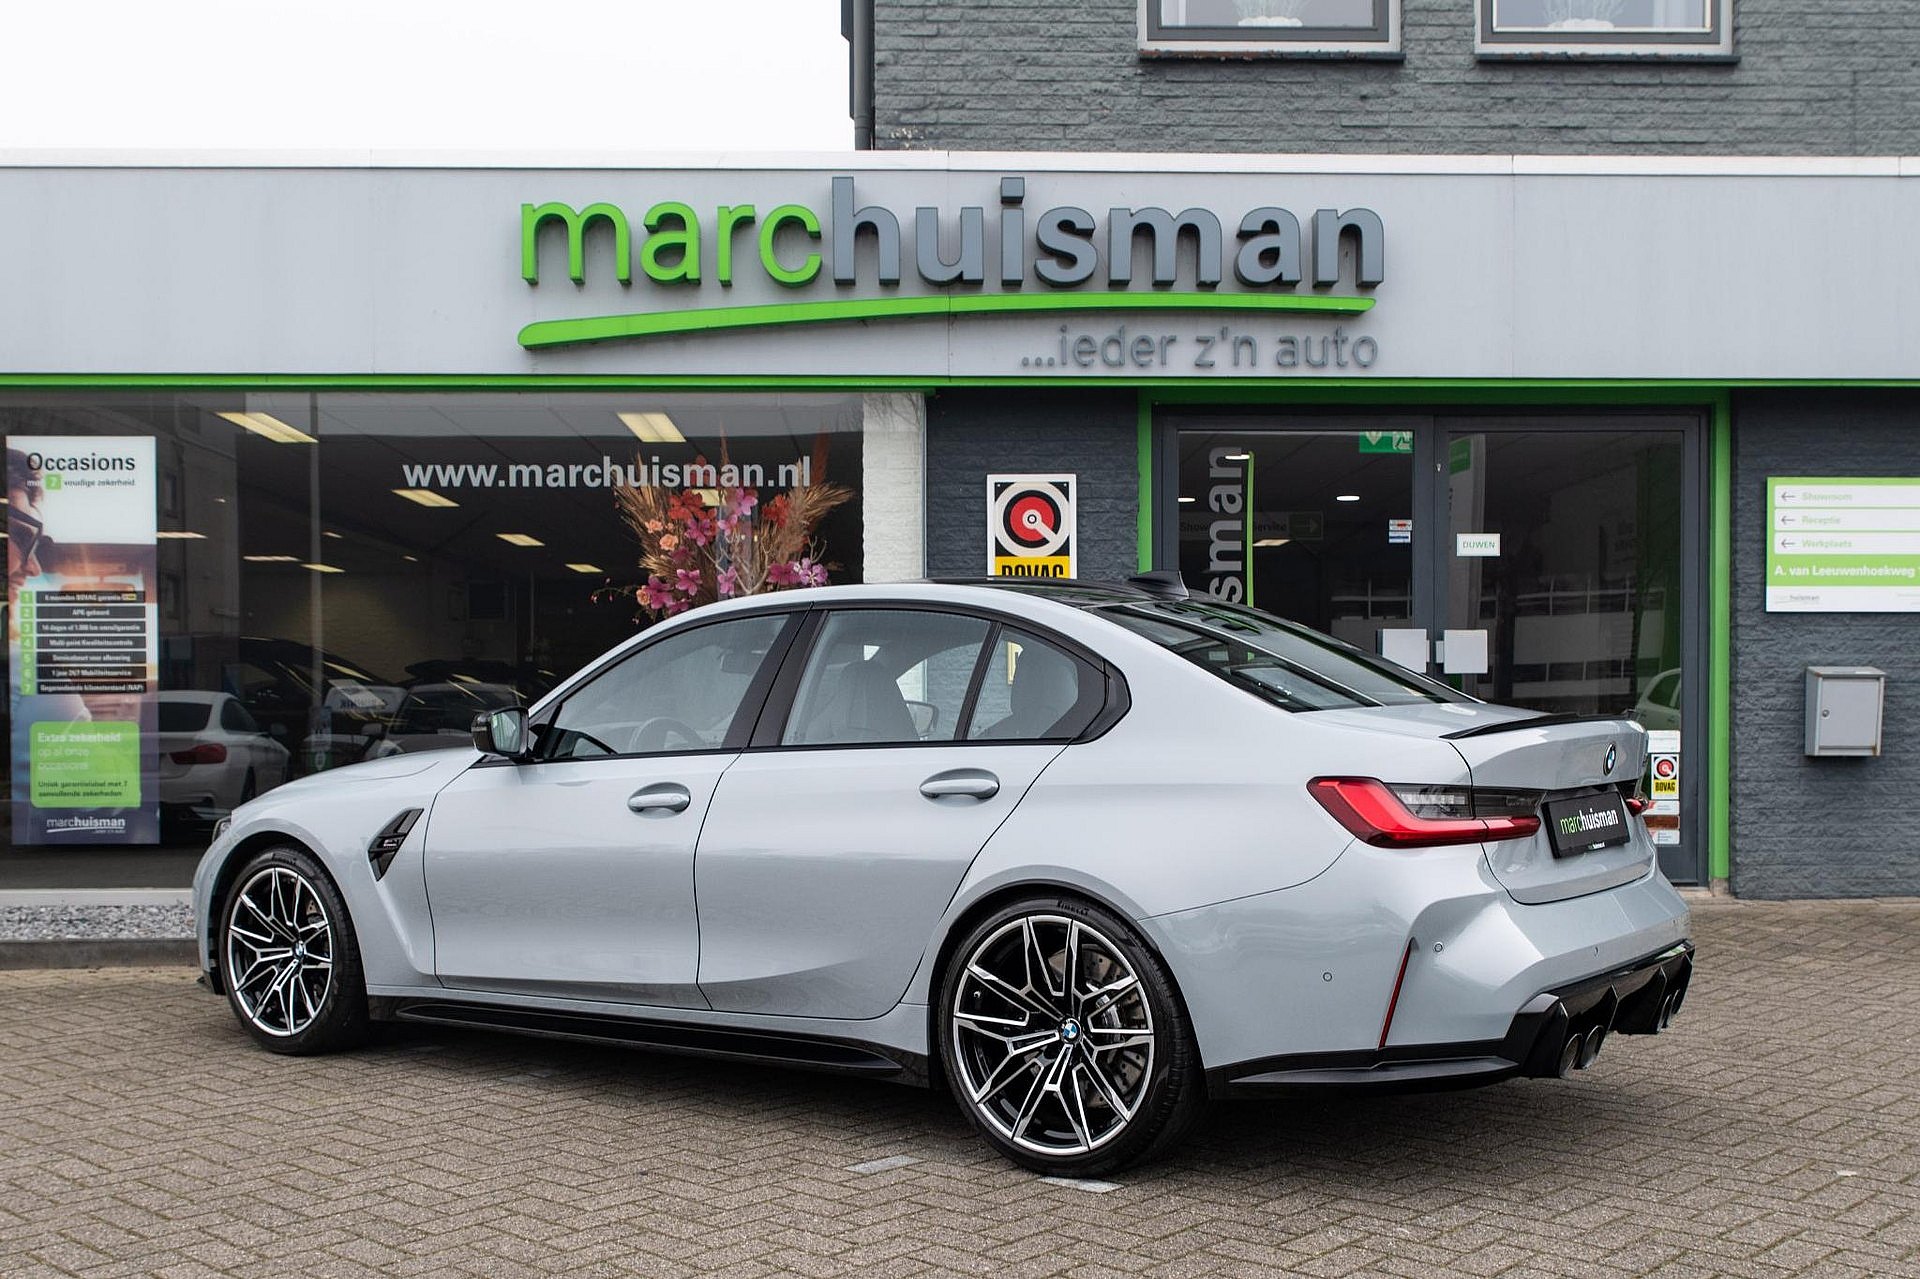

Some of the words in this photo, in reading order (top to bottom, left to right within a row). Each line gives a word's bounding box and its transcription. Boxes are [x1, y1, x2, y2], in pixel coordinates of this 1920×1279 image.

[521, 177, 1384, 289] marchuisman
[1195, 325, 1257, 368] z'n
[1277, 323, 1379, 368] auto
[27, 452, 136, 471] Occasions
[401, 455, 811, 488] www.marchuisman.nl
[1774, 565, 1786, 576] A.
[1789, 567, 1809, 576] van
[1655, 781, 1676, 792] BOVAG
[46, 816, 126, 827] marchuisman
[1560, 808, 1619, 835] marchuisman
